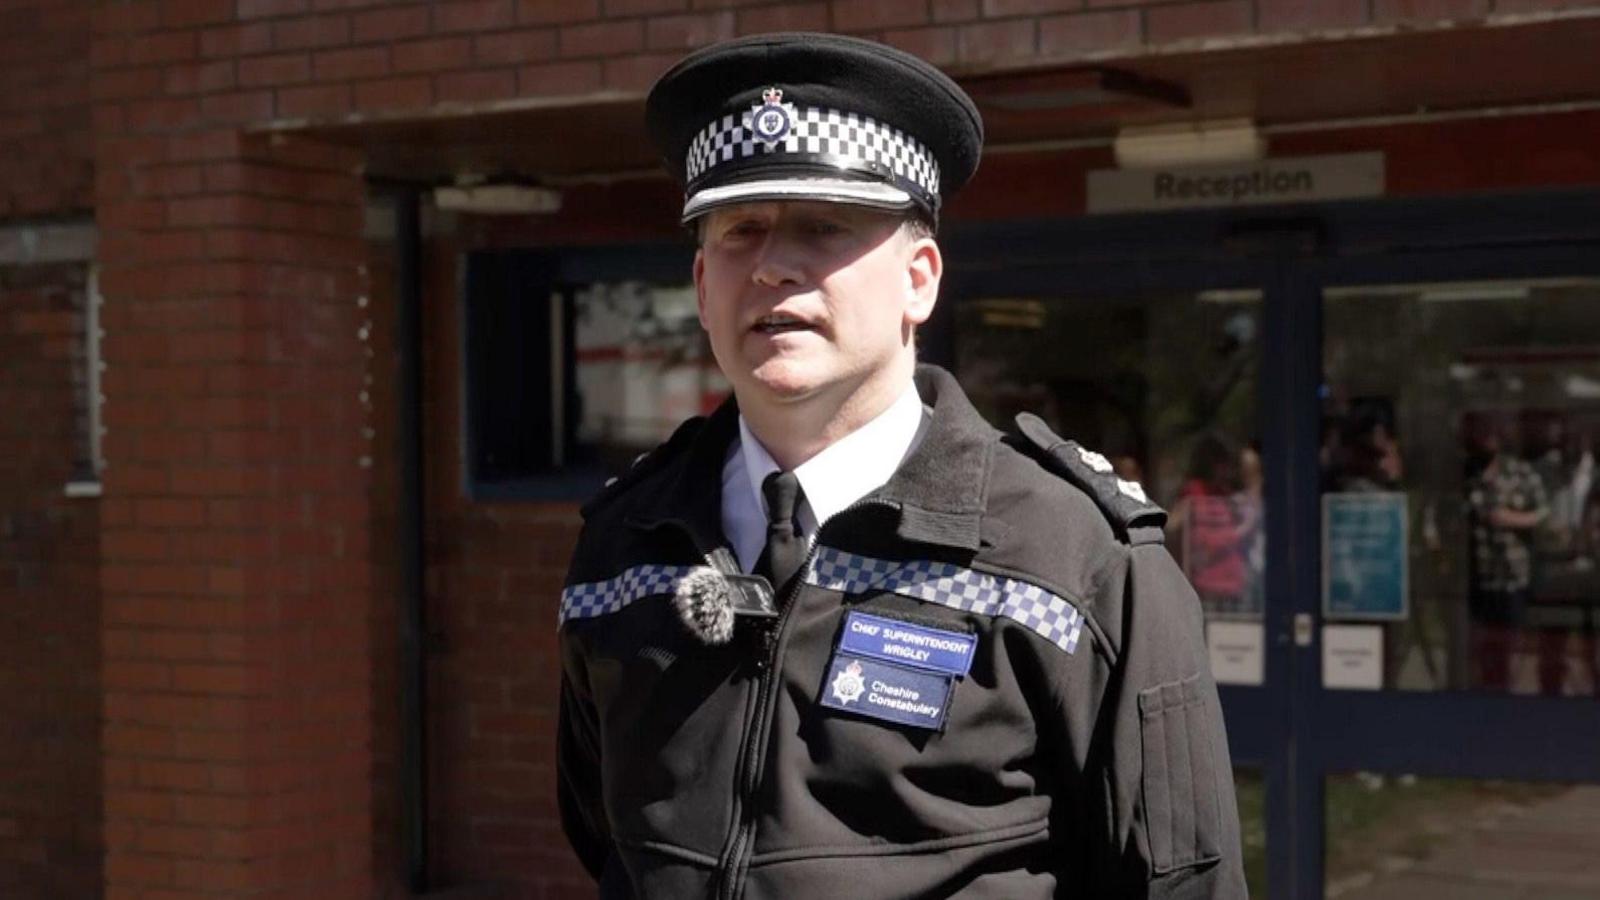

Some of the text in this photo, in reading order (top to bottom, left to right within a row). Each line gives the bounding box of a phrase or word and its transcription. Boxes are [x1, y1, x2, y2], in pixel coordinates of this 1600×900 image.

[1154, 168, 1313, 200] Reception
[852, 622, 969, 654] CHIEF SUPERINTENDENT
[883, 644, 930, 661] WRIGLEY
[872, 680, 920, 700] Cheshire
[869, 693, 940, 717] Constabulary
